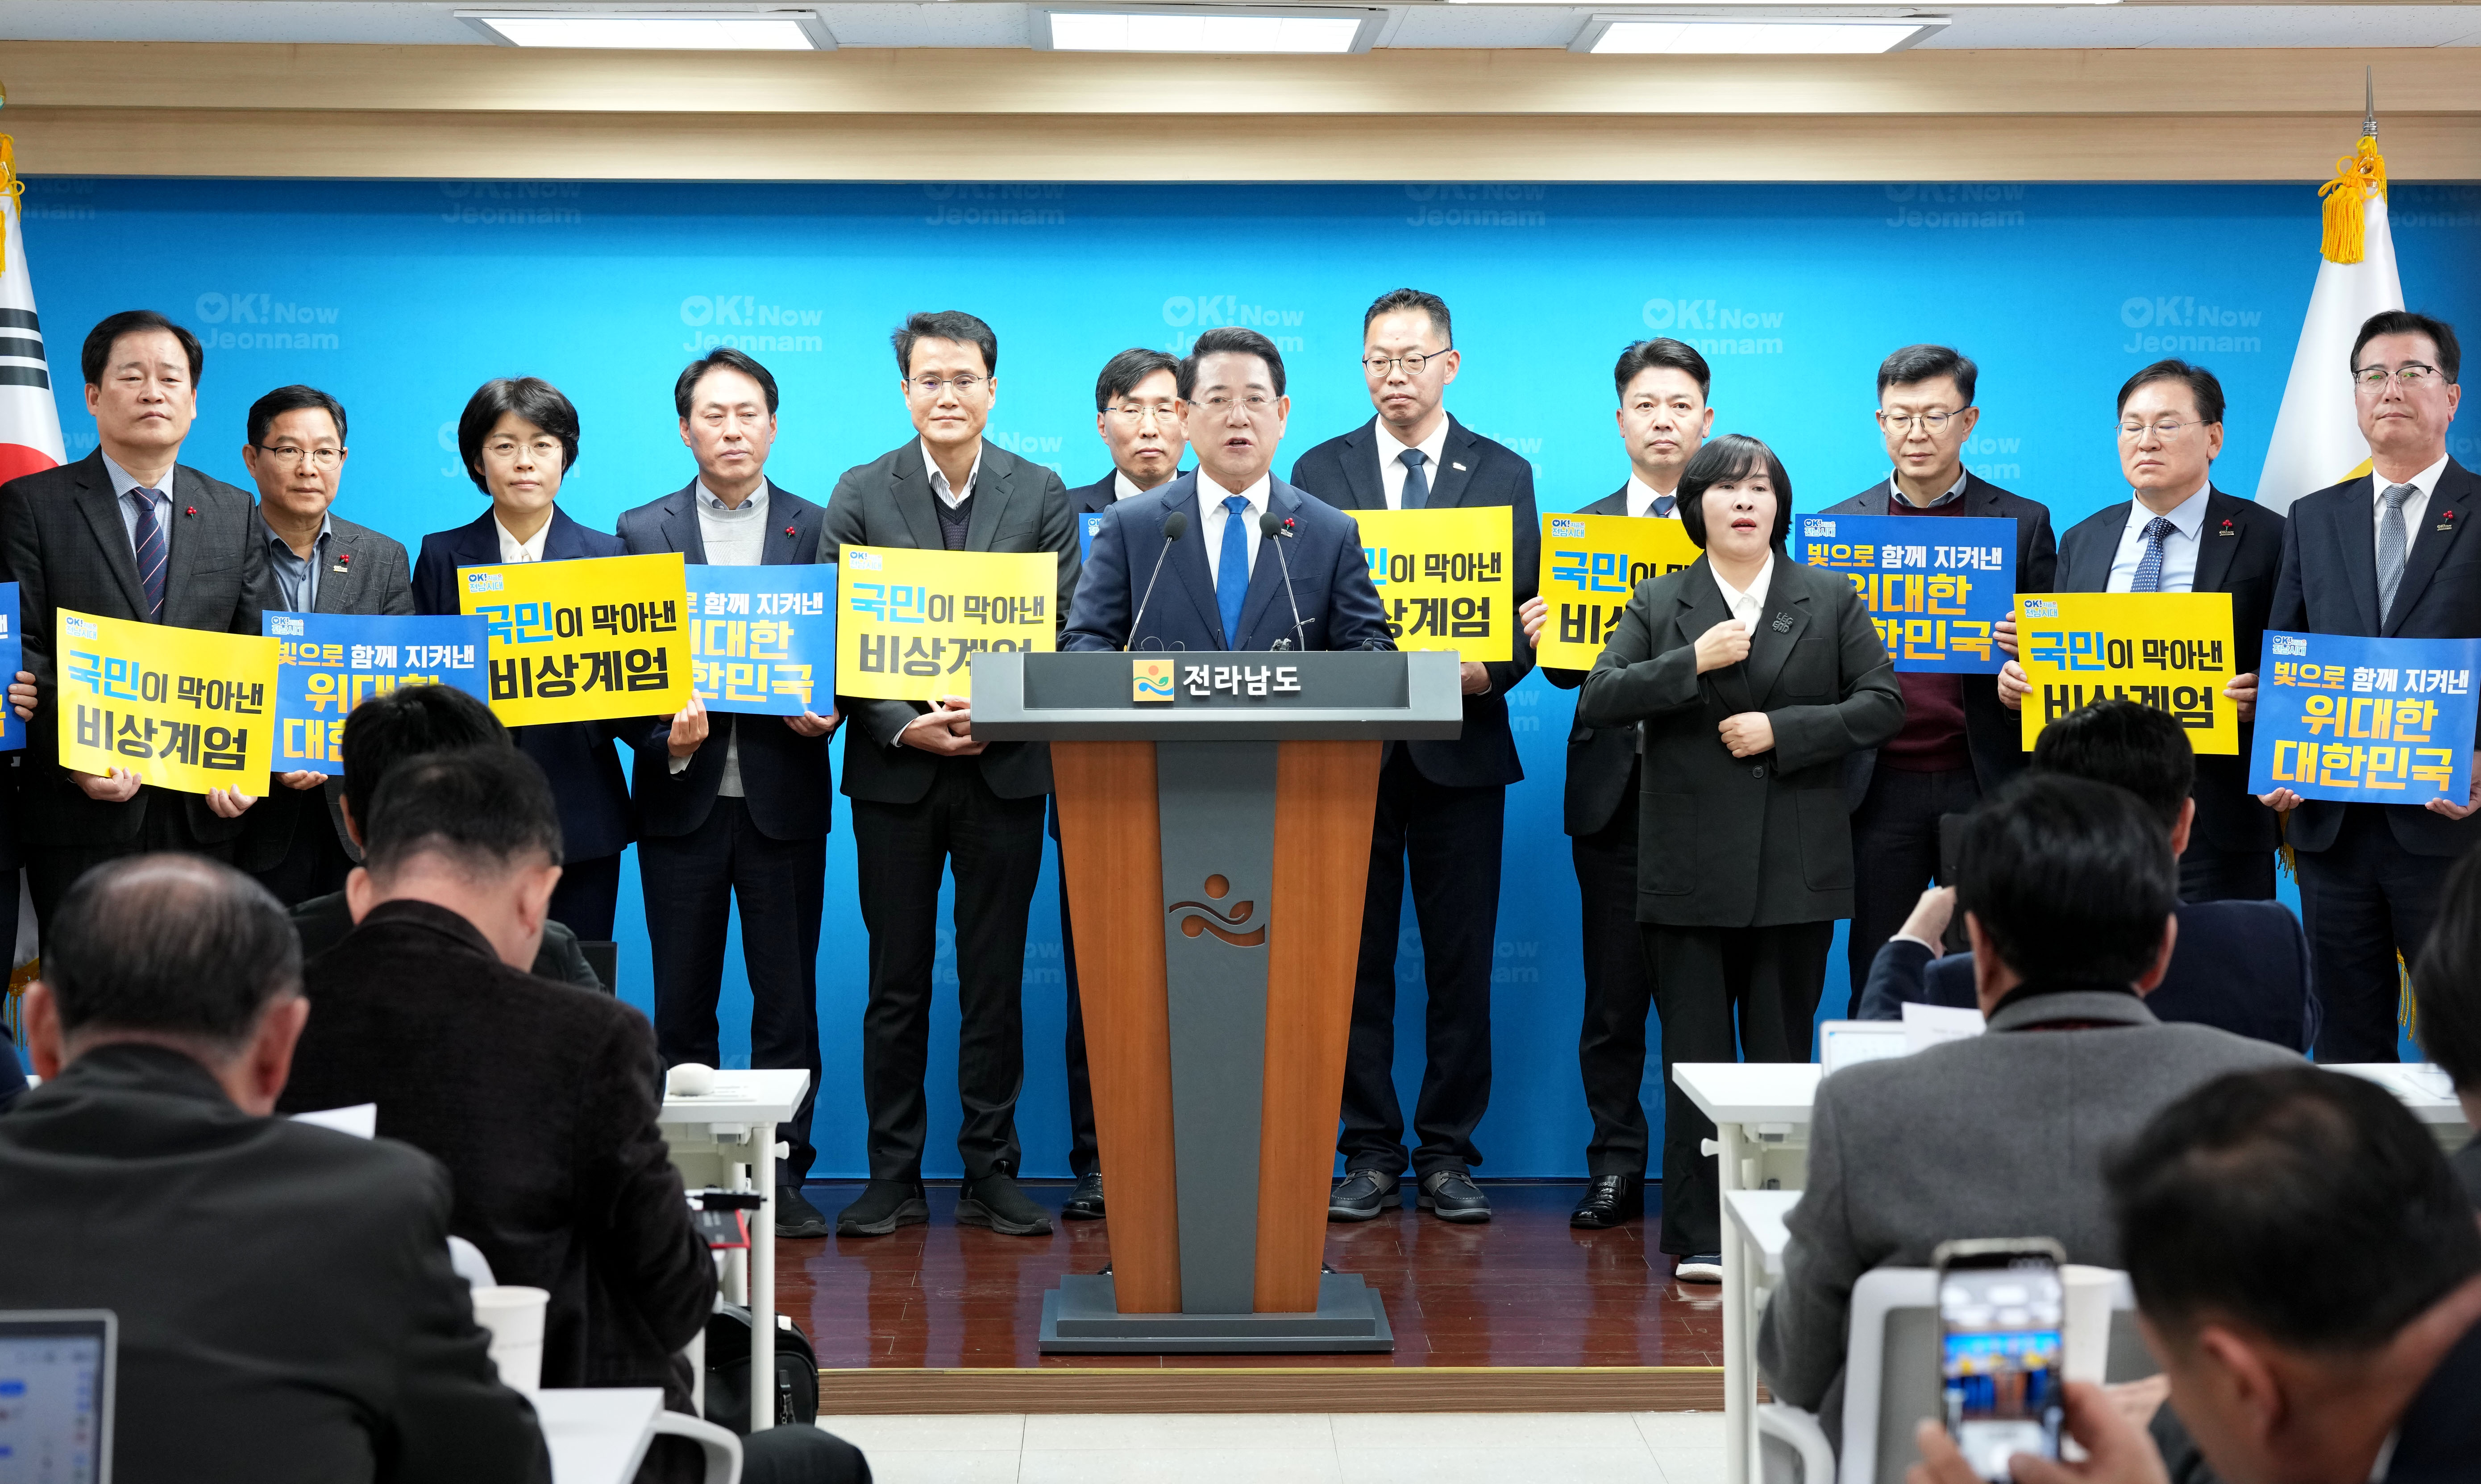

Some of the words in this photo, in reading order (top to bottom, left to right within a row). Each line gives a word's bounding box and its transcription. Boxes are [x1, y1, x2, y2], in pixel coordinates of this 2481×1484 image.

[442, 201, 581, 224] Jeonnam
[925, 204, 1065, 225] Jeonnam
[1406, 205, 1546, 226] Jeonnam
[1887, 206, 2024, 227] Jeonnam
[195, 292, 271, 324] OK!
[274, 303, 339, 324] Now
[680, 295, 755, 327] OK!
[759, 305, 823, 326] Now
[1162, 295, 1236, 327] OK!
[1241, 305, 1304, 326] Now
[1642, 298, 1716, 330] OK!
[1720, 308, 1784, 329] Now
[2121, 296, 2195, 328] OK!
[2198, 306, 2262, 327] Now
[200, 328, 339, 349] Jeonnam
[2124, 333, 2261, 353] Jeonnam
[1552, 519, 1570, 528] OK!
[1552, 528, 1585, 538] 전남시대
[1804, 519, 1822, 528] OK!
[1804, 527, 1836, 537] 전남시대
[850, 551, 867, 560] OK!
[1363, 548, 1415, 585] 민이
[1425, 552, 1501, 583] 막아낸
[1808, 543, 1874, 567] 빛으로
[1882, 544, 1926, 569] 함께
[1934, 546, 2002, 570] 지켜낸
[468, 573, 487, 582] OK!
[1552, 551, 1656, 593] 국민이
[469, 581, 503, 592] 전남시대
[704, 592, 749, 615] 함께
[756, 592, 823, 615] 지켜낸
[851, 582, 954, 624] 국민이
[964, 595, 1044, 625] 막아낸
[2024, 600, 2042, 608] OK!
[2024, 608, 2058, 618] 전남시대
[66, 616, 83, 627] OK!
[271, 616, 290, 625] OK!
[271, 625, 304, 636] 전남시대
[475, 601, 583, 644] 국민이
[591, 600, 677, 636] 막아낸
[1381, 597, 1490, 638] 상계엄
[66, 626, 98, 640] 전남시대
[690, 619, 794, 660] 대한
[1871, 617, 1993, 661] 한민국
[2273, 636, 2292, 645] OK!
[351, 644, 397, 669] 함께
[405, 644, 474, 669] 지켜낸
[860, 633, 1032, 677] 비상계
[2030, 632, 2133, 671] 국민이
[2142, 639, 2223, 672] 막아낸
[2273, 644, 2306, 656] 전남시대
[68, 650, 168, 703] 국민이
[177, 676, 264, 715] 막아낸
[489, 647, 669, 701] 비상계엄
[692, 659, 815, 703] 한민국
[1183, 665, 1301, 695] 전라남도
[2273, 661, 2345, 690] 빛으로
[2352, 666, 2398, 692] 함께
[2404, 669, 2469, 694] 지켜낸
[2301, 694, 2439, 742] 위대한
[77, 704, 248, 771] 비상계엄
[2272, 740, 2453, 791] 대한민국
